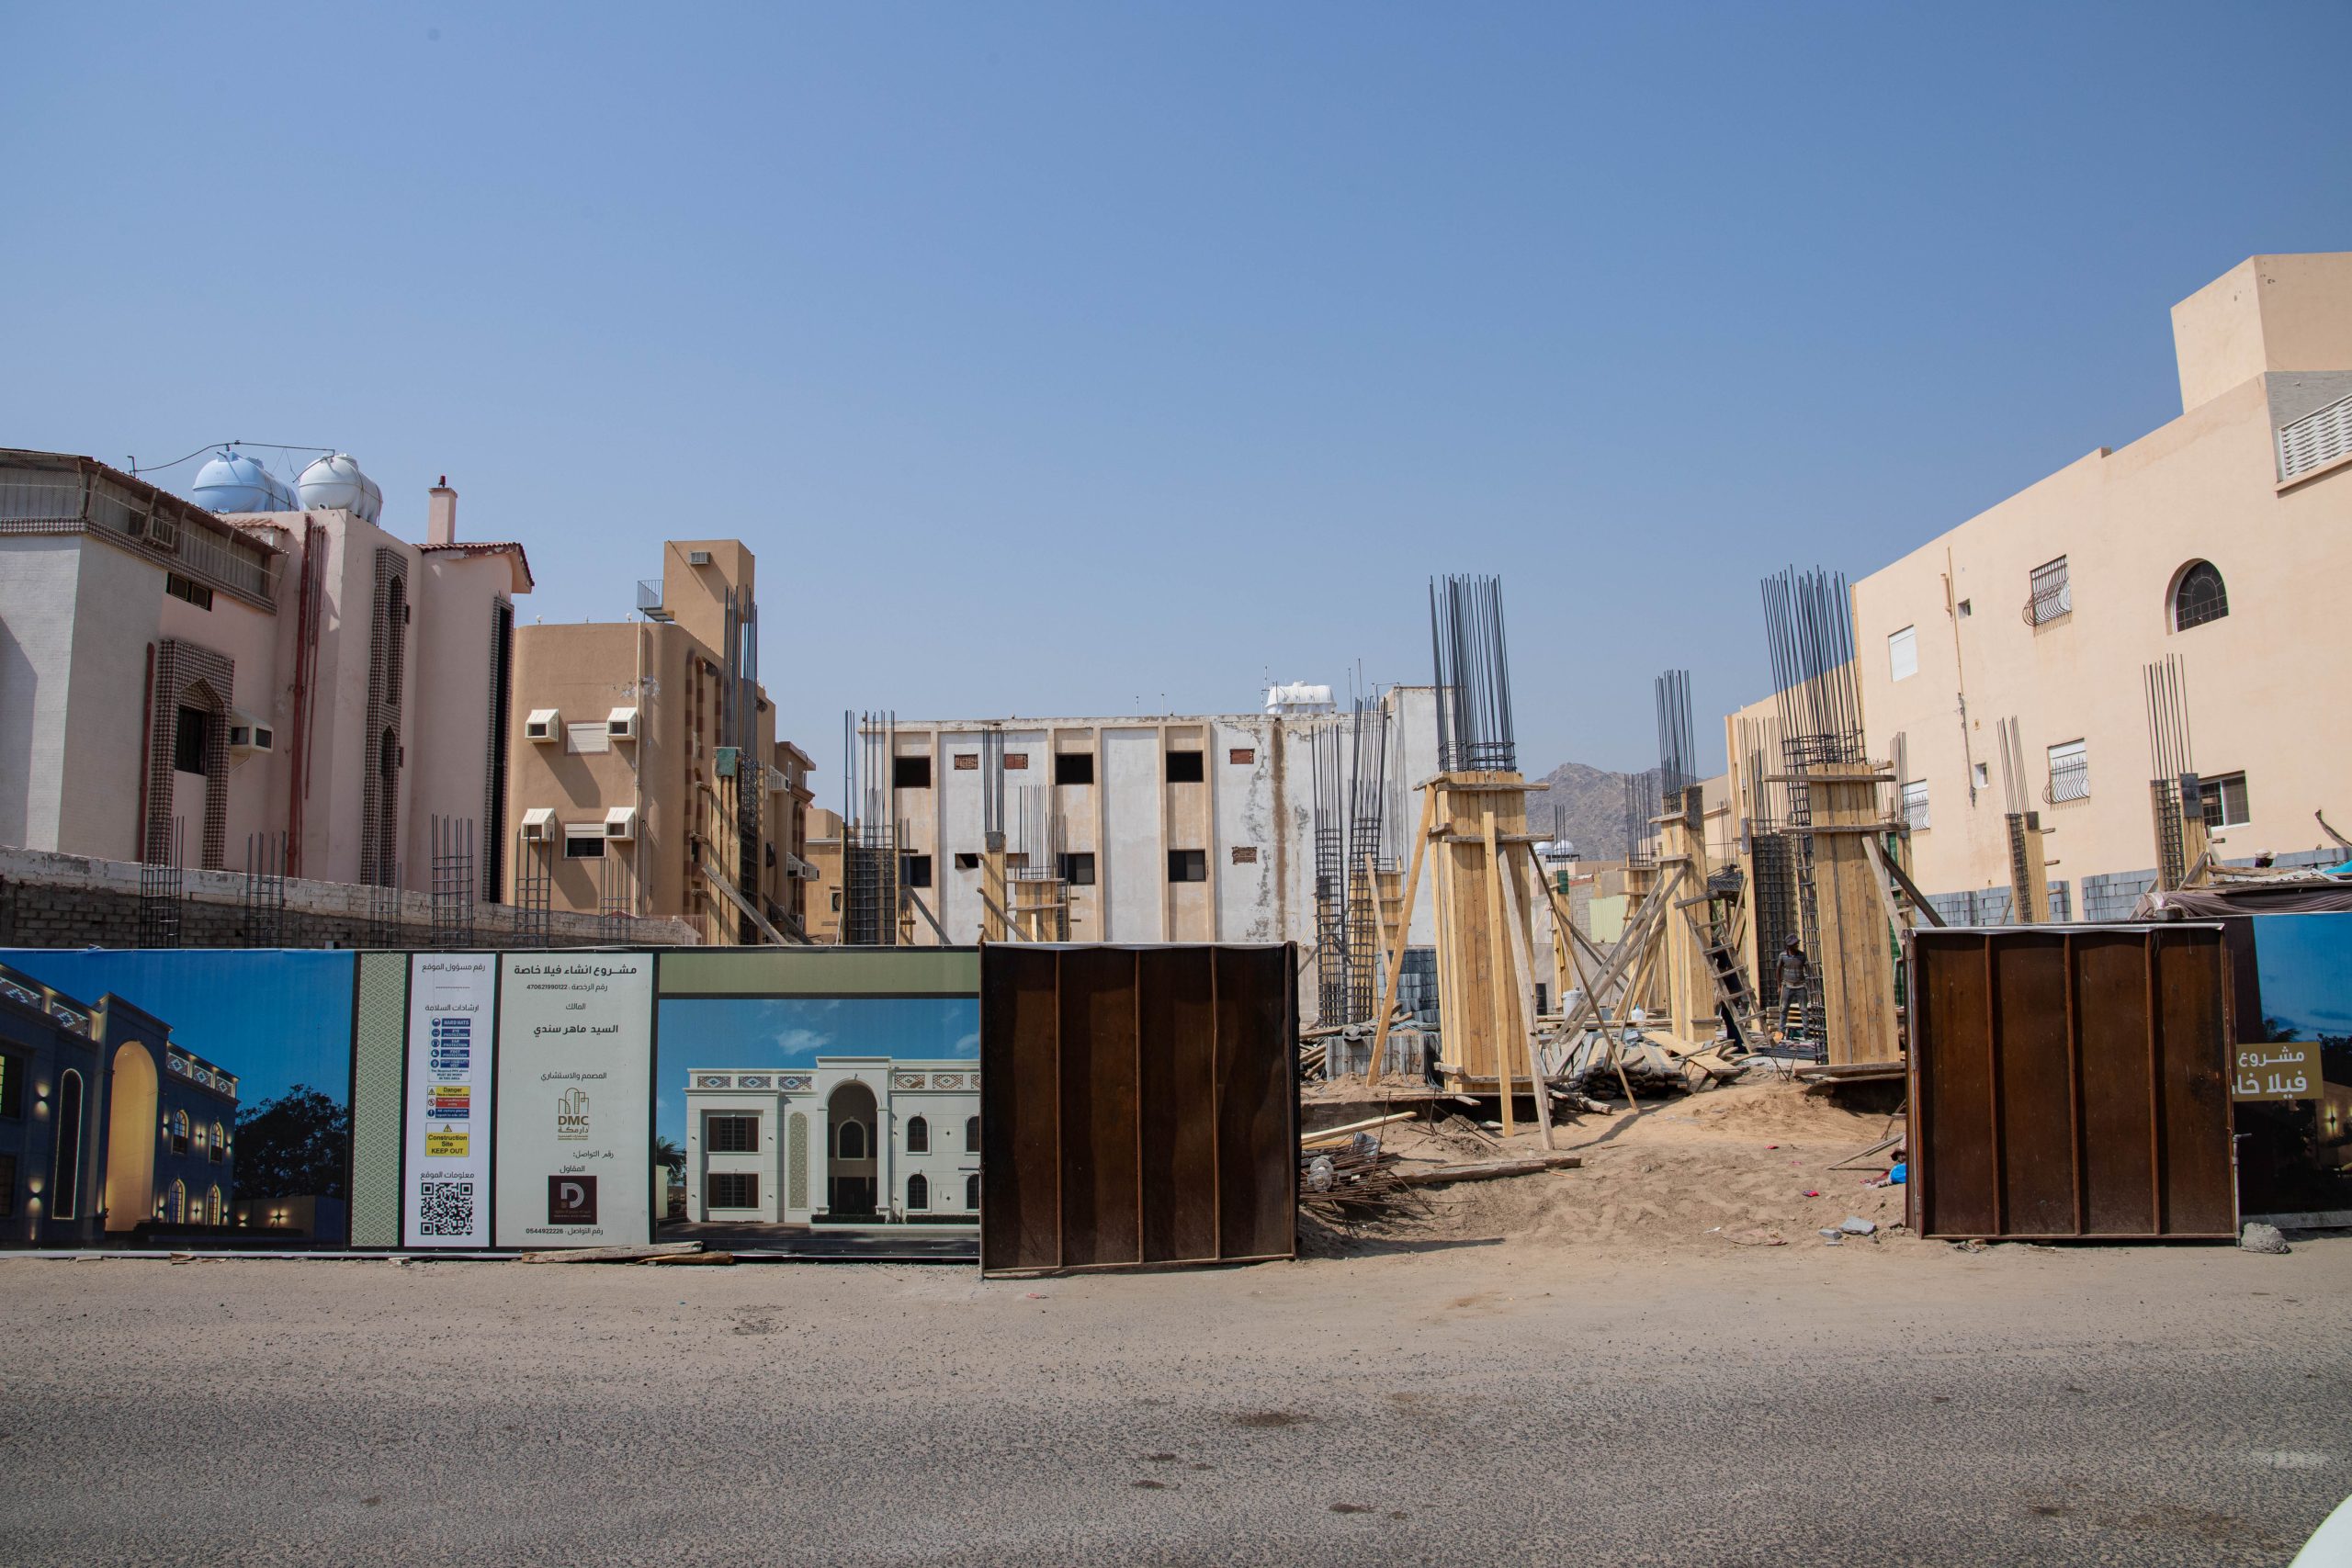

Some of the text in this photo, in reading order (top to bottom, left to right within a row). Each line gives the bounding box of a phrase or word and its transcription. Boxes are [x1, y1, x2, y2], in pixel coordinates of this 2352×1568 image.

[422, 963, 485, 973] رقم مسؤول الموقع
[514, 964, 637, 976] مشروع انشاء فيلا خاصة
[571, 983, 594, 992] الرخصة
[594, 983, 608, 992] رقم
[565, 1002, 586, 1010] المالك
[533, 1024, 618, 1038] السيد ماهر سندي
[2238, 1045, 2305, 1067] مشروع
[581, 1072, 607, 1082] المصمم
[2266, 1069, 2307, 1100] فيلا
[558, 1115, 589, 1126] DMC
[602, 1150, 615, 1158] رقم
[560, 1165, 586, 1173] المقاول
[420, 1171, 443, 1180] الموقع
[592, 1228, 604, 1236] رقم
